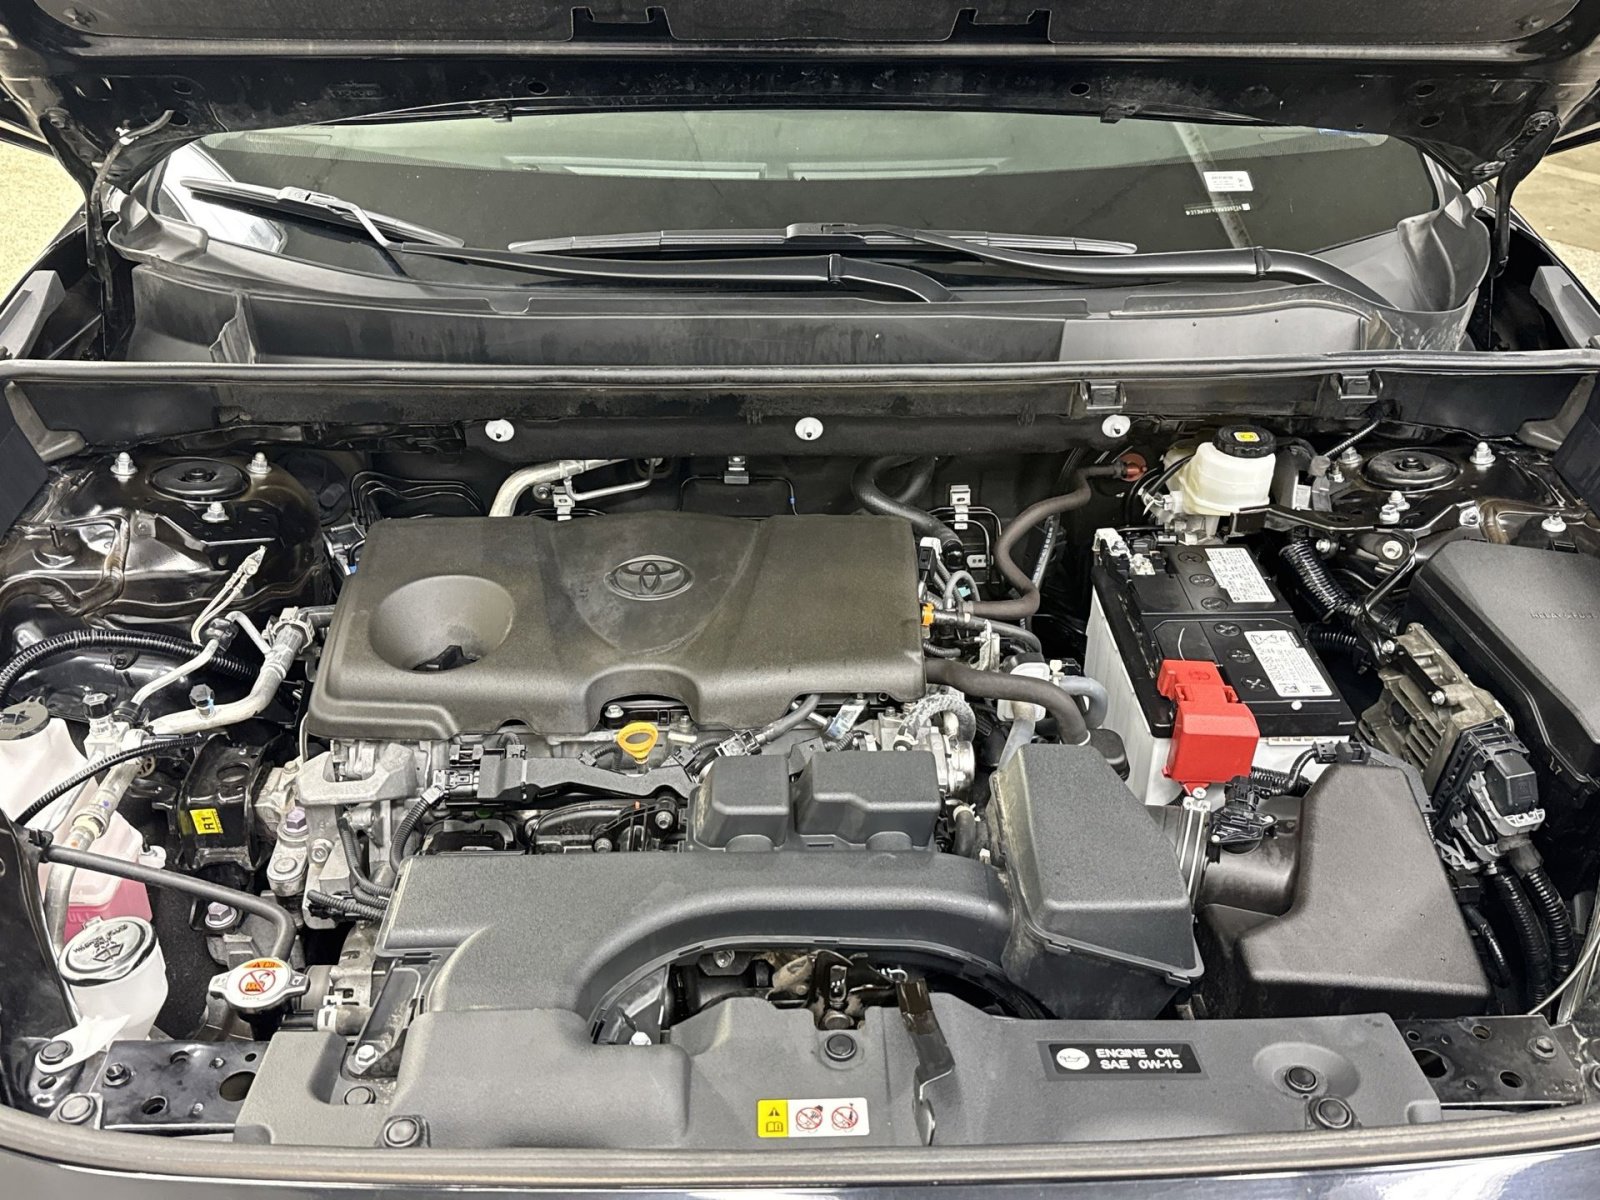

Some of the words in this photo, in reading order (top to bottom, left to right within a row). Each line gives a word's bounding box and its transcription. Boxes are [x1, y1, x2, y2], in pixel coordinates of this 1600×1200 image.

[1095, 1048, 1148, 1058] ENGINE
[1154, 1048, 1179, 1058] OIL
[1100, 1059, 1130, 1070] SAE
[1138, 1059, 1183, 1070] 0W-16
